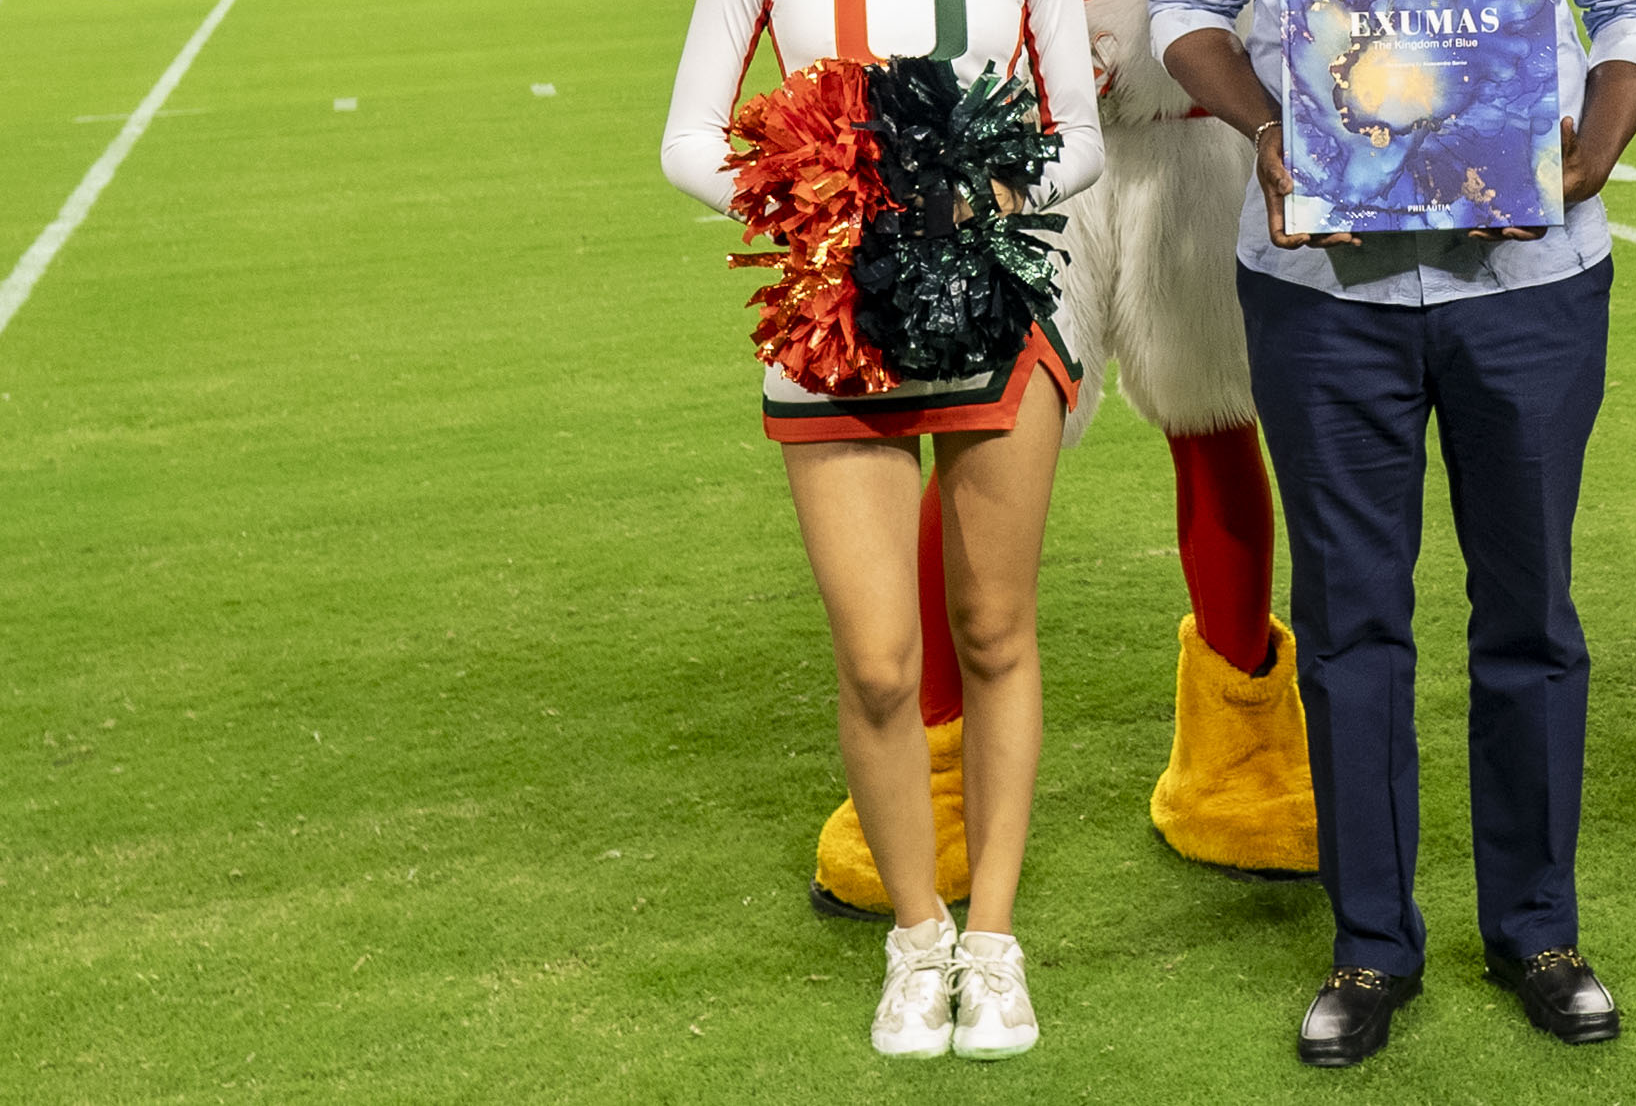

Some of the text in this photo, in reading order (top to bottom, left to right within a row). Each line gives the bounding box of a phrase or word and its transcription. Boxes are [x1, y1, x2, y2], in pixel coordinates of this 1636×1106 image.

[1350, 6, 1500, 38] EXUMAS
[1372, 37, 1479, 51] The Kingdom of Blue
